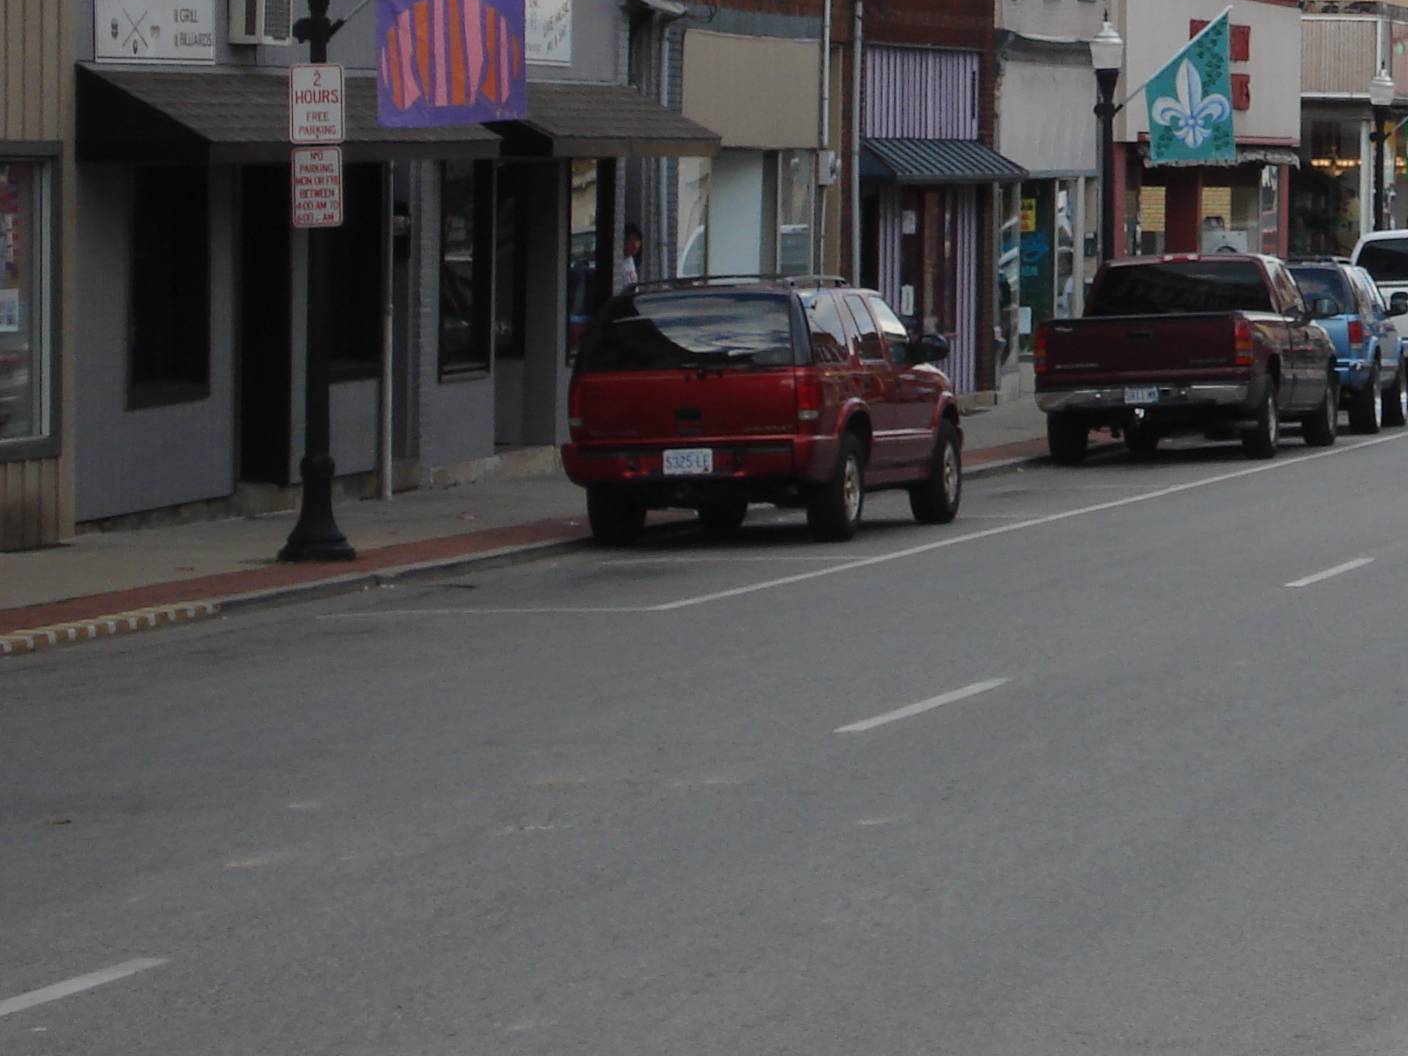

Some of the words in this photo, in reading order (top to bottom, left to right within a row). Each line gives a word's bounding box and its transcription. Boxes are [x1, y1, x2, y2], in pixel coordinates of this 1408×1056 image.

[313, 72, 322, 87] 2
[295, 89, 339, 104] HOURS
[306, 111, 330, 122] FREE
[299, 125, 337, 136] PARKING
[310, 151, 323, 161] NO
[300, 164, 334, 174] PARKING
[300, 188, 335, 199] BETWEEN
